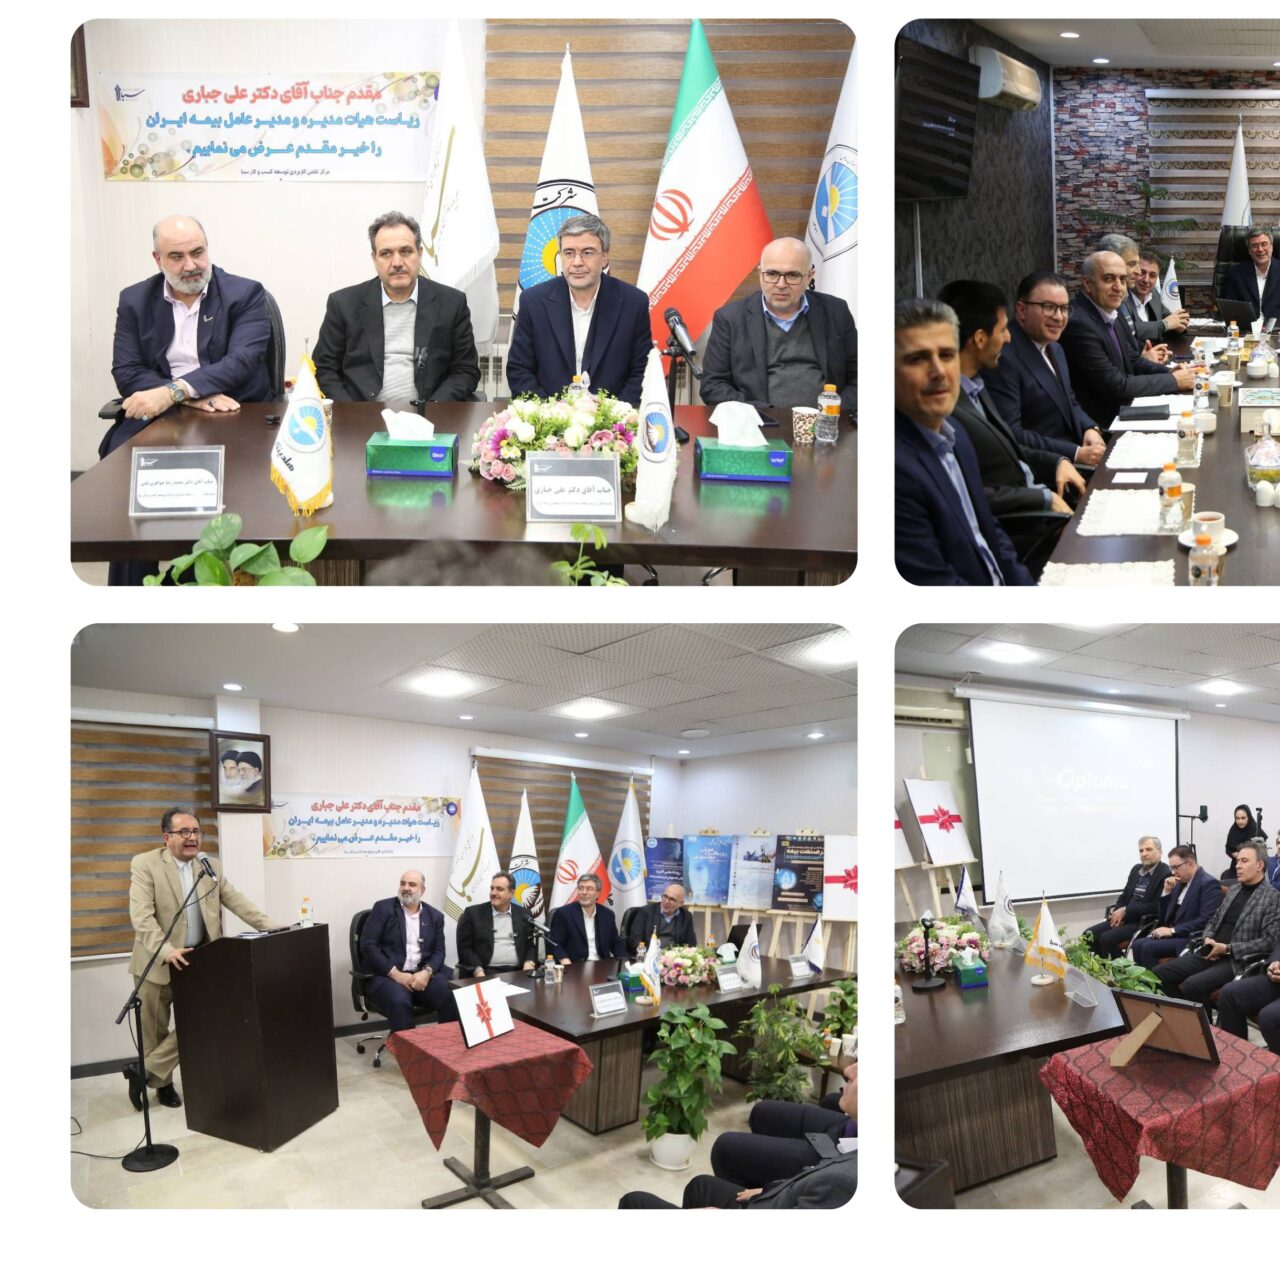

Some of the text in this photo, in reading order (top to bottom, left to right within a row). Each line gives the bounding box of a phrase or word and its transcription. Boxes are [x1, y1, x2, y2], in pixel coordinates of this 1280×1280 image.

[182, 80, 382, 106] مقدم جناب آقای دکتر علی جباری
[146, 111, 420, 129] ریاست هیات مدیره و مدیر عامل بیمه ایران
[229, 145, 247, 158] می
[248, 140, 294, 158] عرض
[295, 140, 337, 159] مقدم
[338, 141, 370, 158] خیر
[371, 140, 383, 158] را
[532, 186, 577, 209] شرکت
